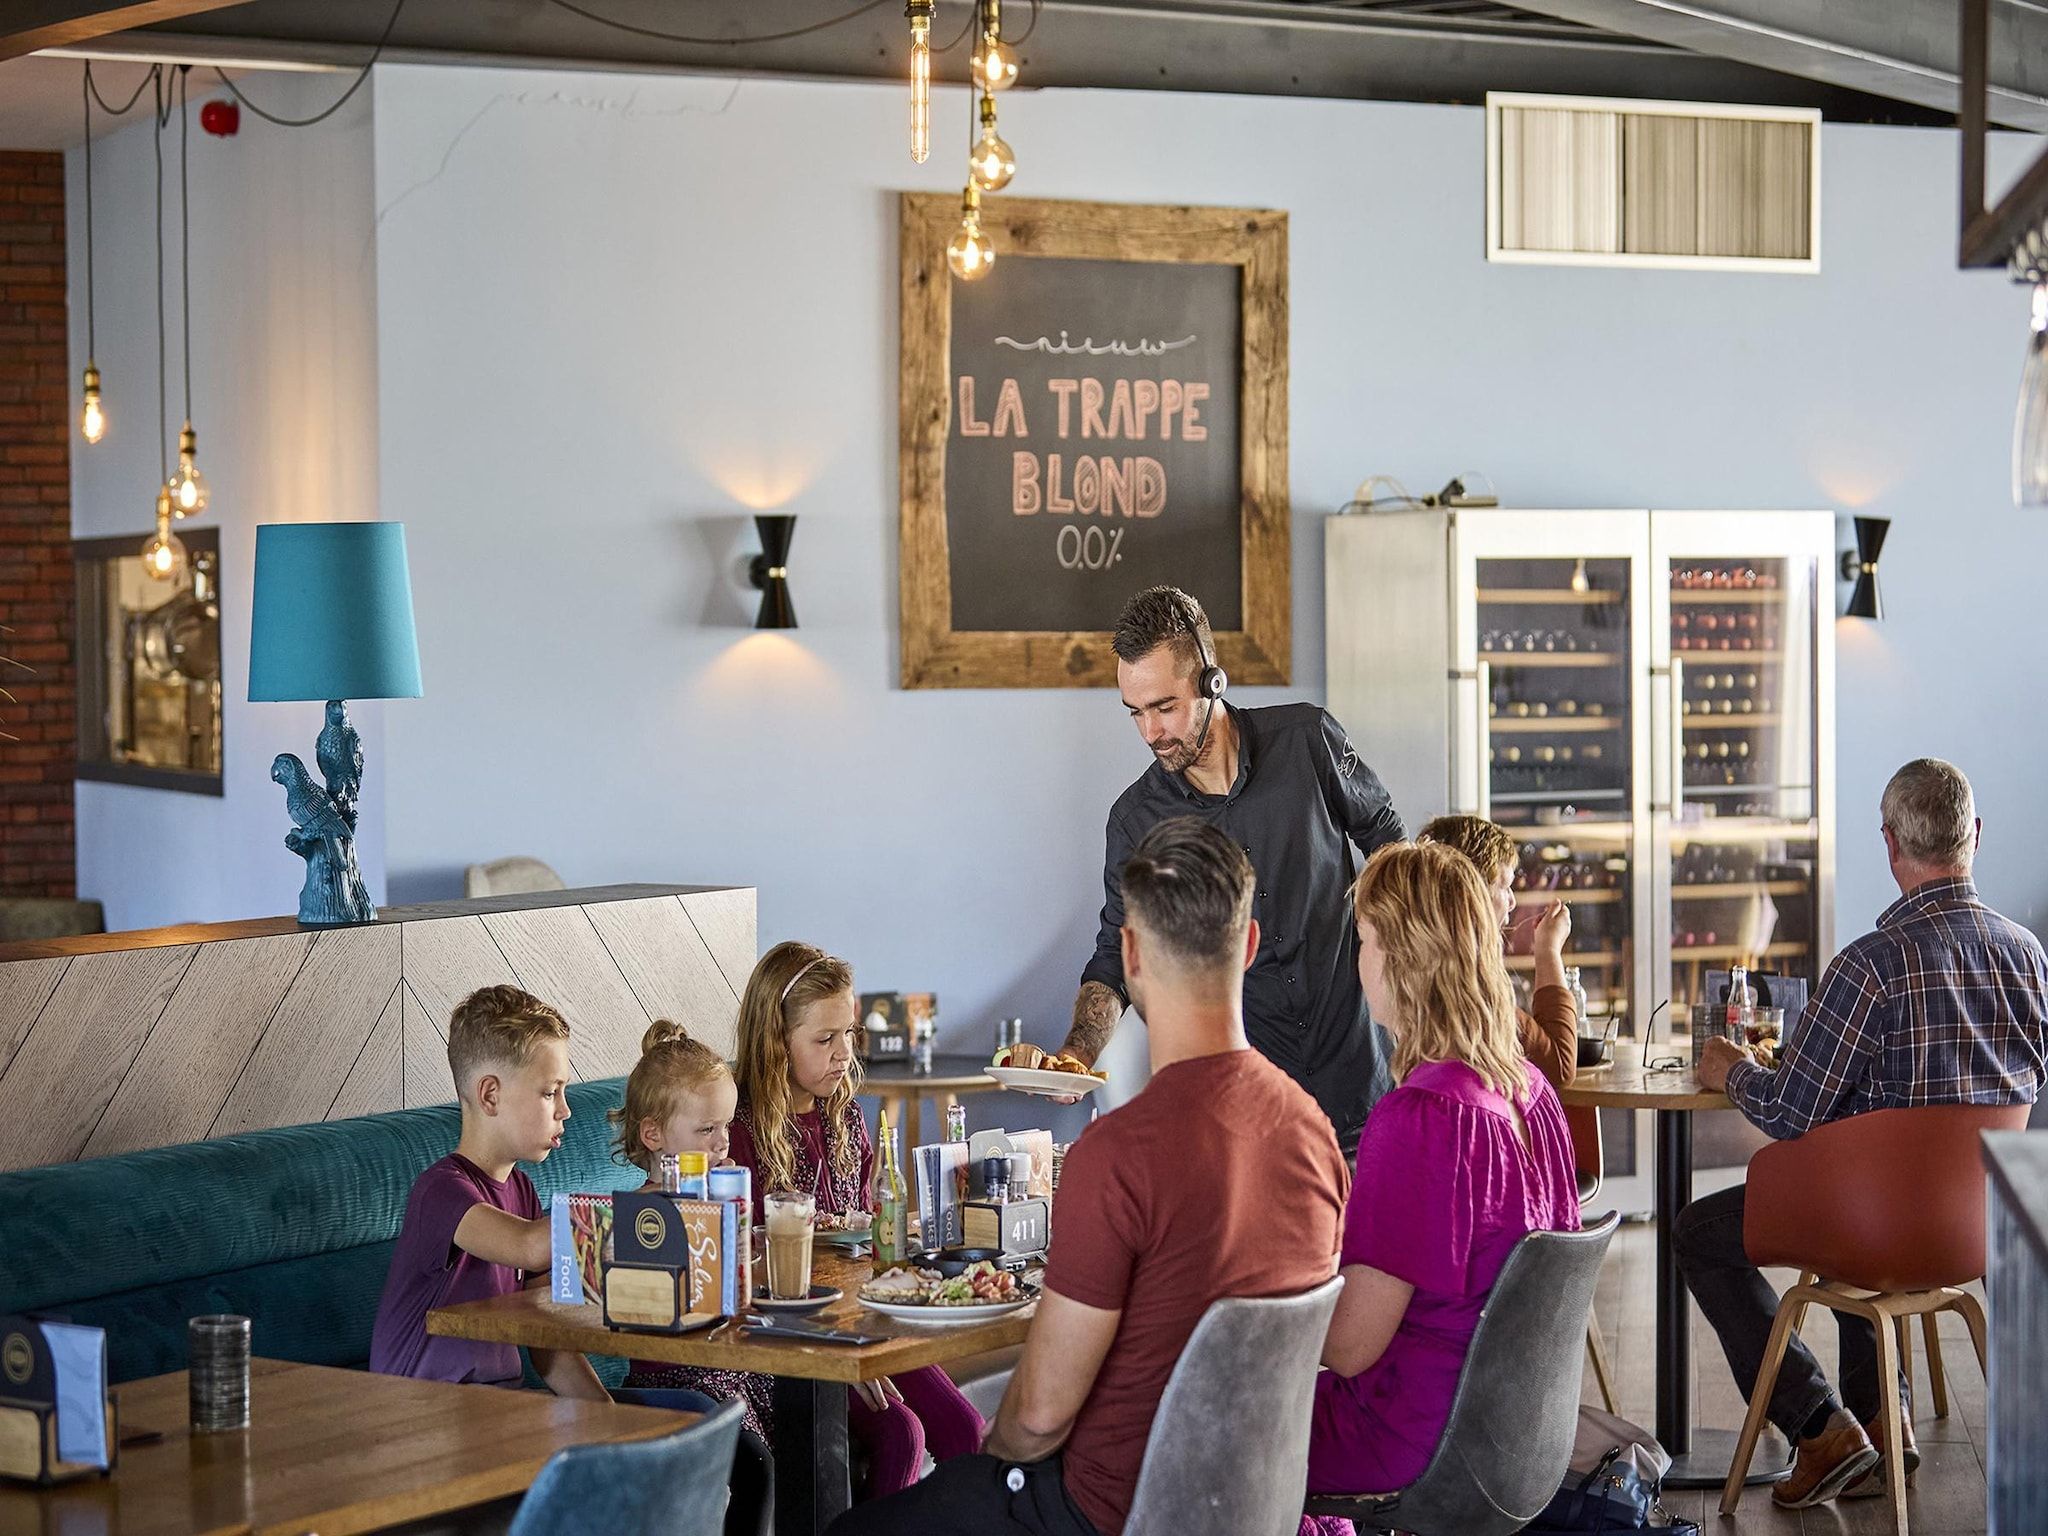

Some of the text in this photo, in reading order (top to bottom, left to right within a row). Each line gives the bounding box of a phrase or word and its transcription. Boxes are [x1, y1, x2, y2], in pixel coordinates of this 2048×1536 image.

[995, 330, 1196, 355] nieuw
[958, 376, 1210, 441] LA TRAPPE
[1013, 451, 1167, 518] BLOND
[1057, 524, 1125, 570] 0.0%
[926, 1184, 935, 1242] Drinks
[946, 1202, 954, 1241] Food
[1012, 1218, 1035, 1242] 411
[560, 1255, 573, 1299] Food
